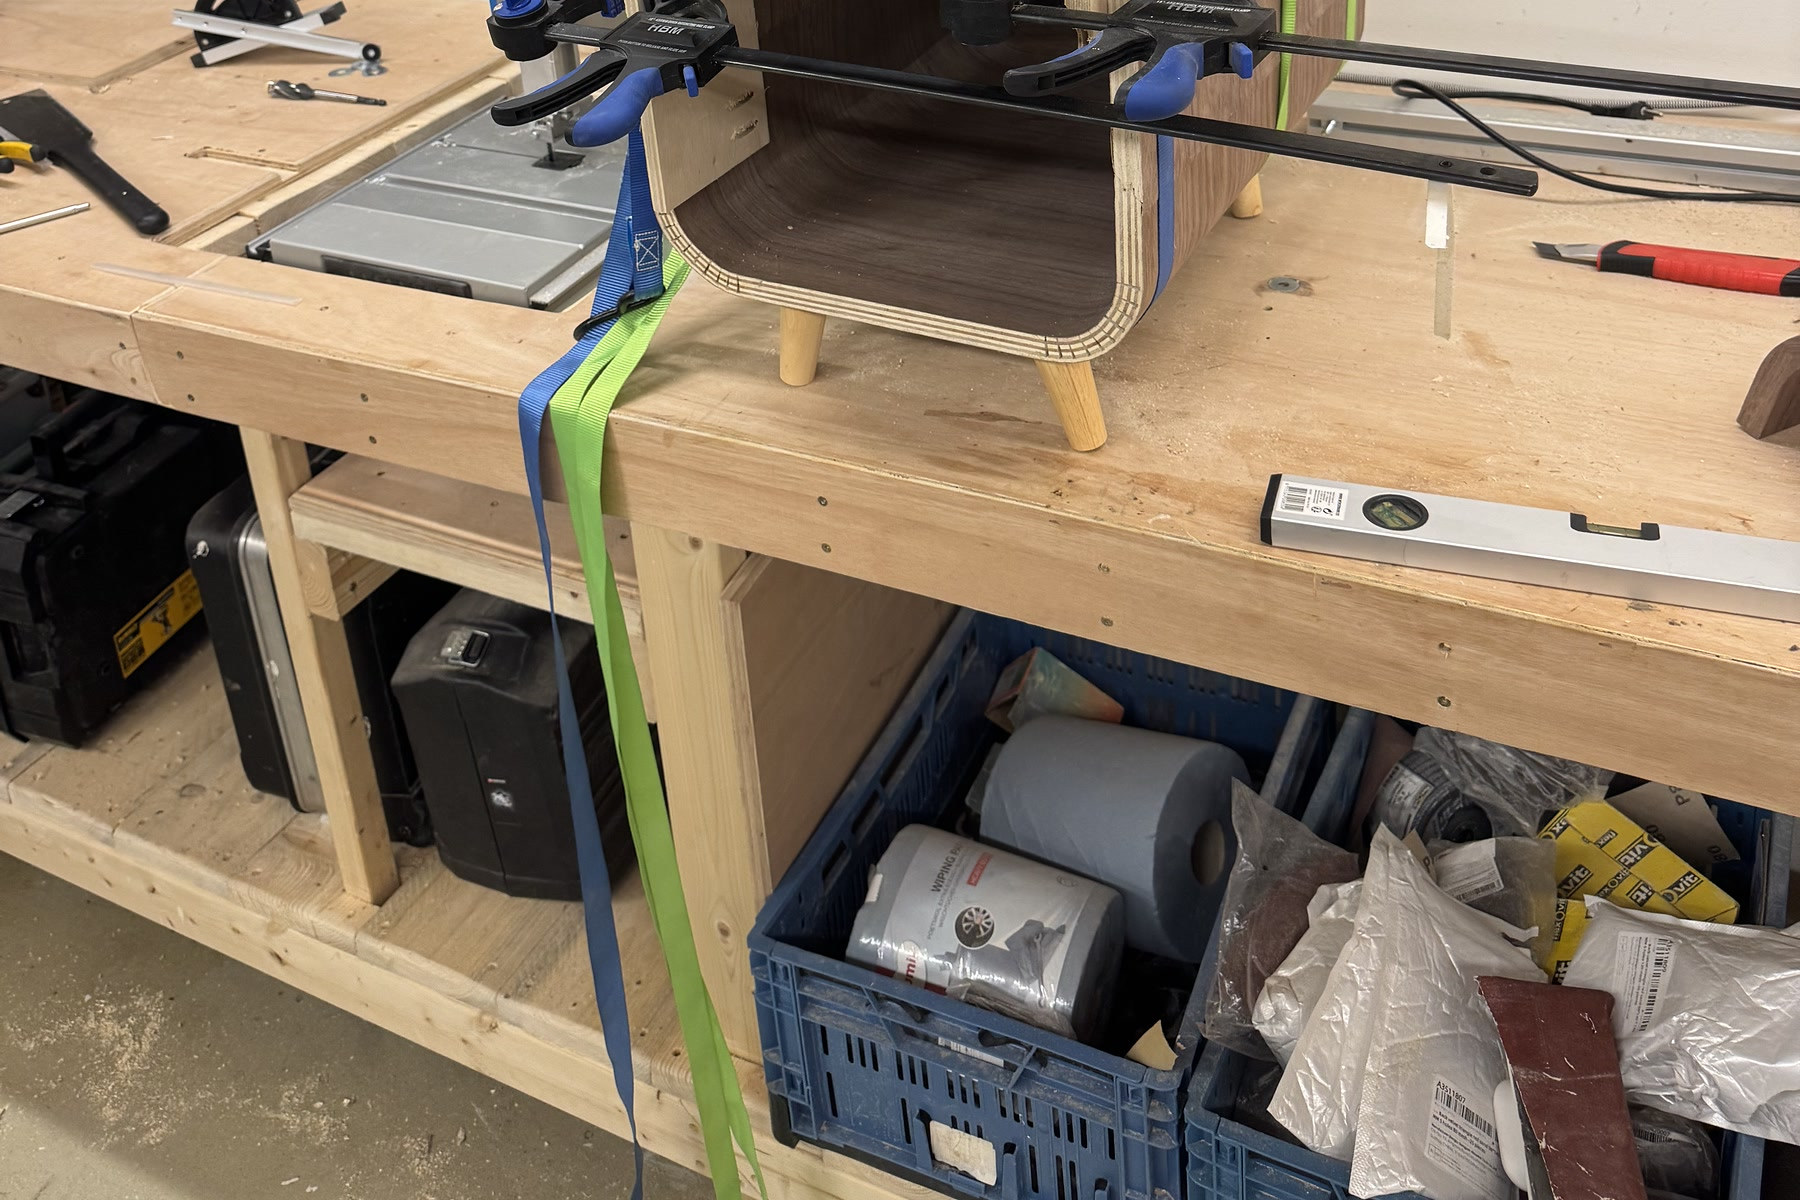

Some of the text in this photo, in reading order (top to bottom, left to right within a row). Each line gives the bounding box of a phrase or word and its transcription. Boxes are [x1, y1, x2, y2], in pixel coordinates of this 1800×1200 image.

[647, 23, 685, 35] HBM
[931, 856, 956, 893] WIPING
[1436, 1081, 1466, 1104] A3511807
